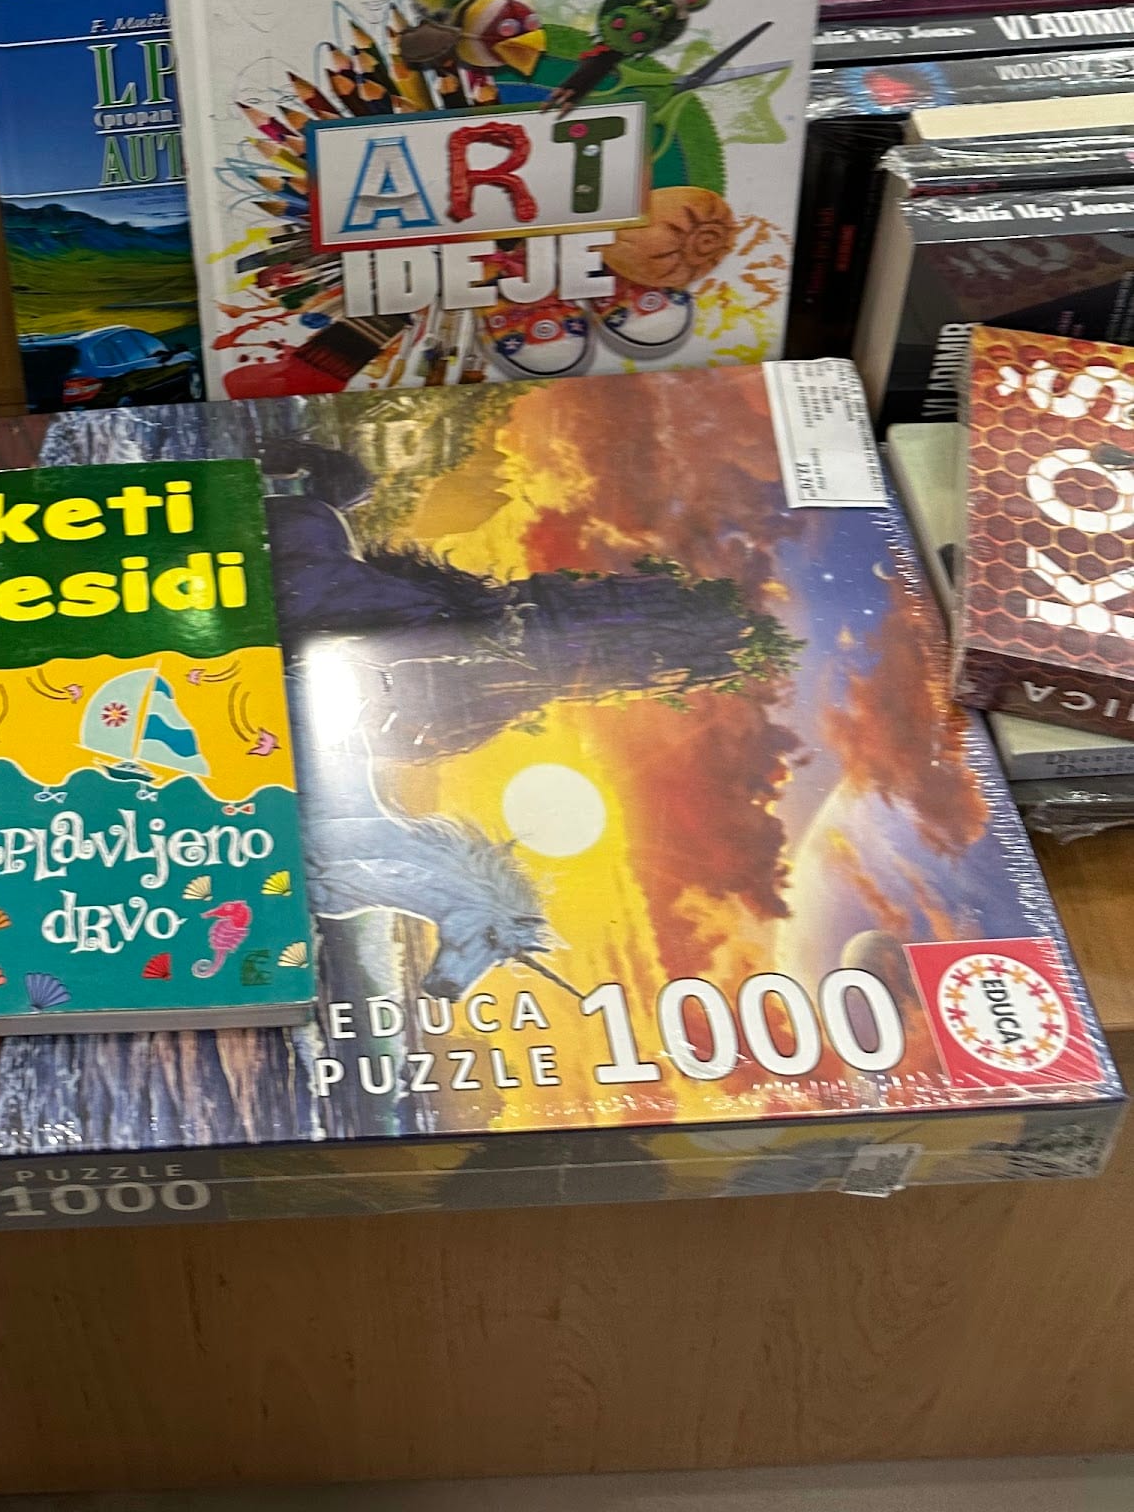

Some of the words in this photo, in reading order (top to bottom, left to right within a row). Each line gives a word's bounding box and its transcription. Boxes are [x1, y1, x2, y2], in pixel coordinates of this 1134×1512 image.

[340, 114, 629, 236] ART
[343, 231, 617, 319] IDEJE
[327, 988, 552, 1043] EDUCA
[579, 966, 909, 1089] 1000
[975, 971, 1020, 1050] EDUCA
[316, 1043, 563, 1099] PUZZLE
[0, 1178, 212, 1218] 1000
[15, 1162, 185, 1183] PUZZLE
